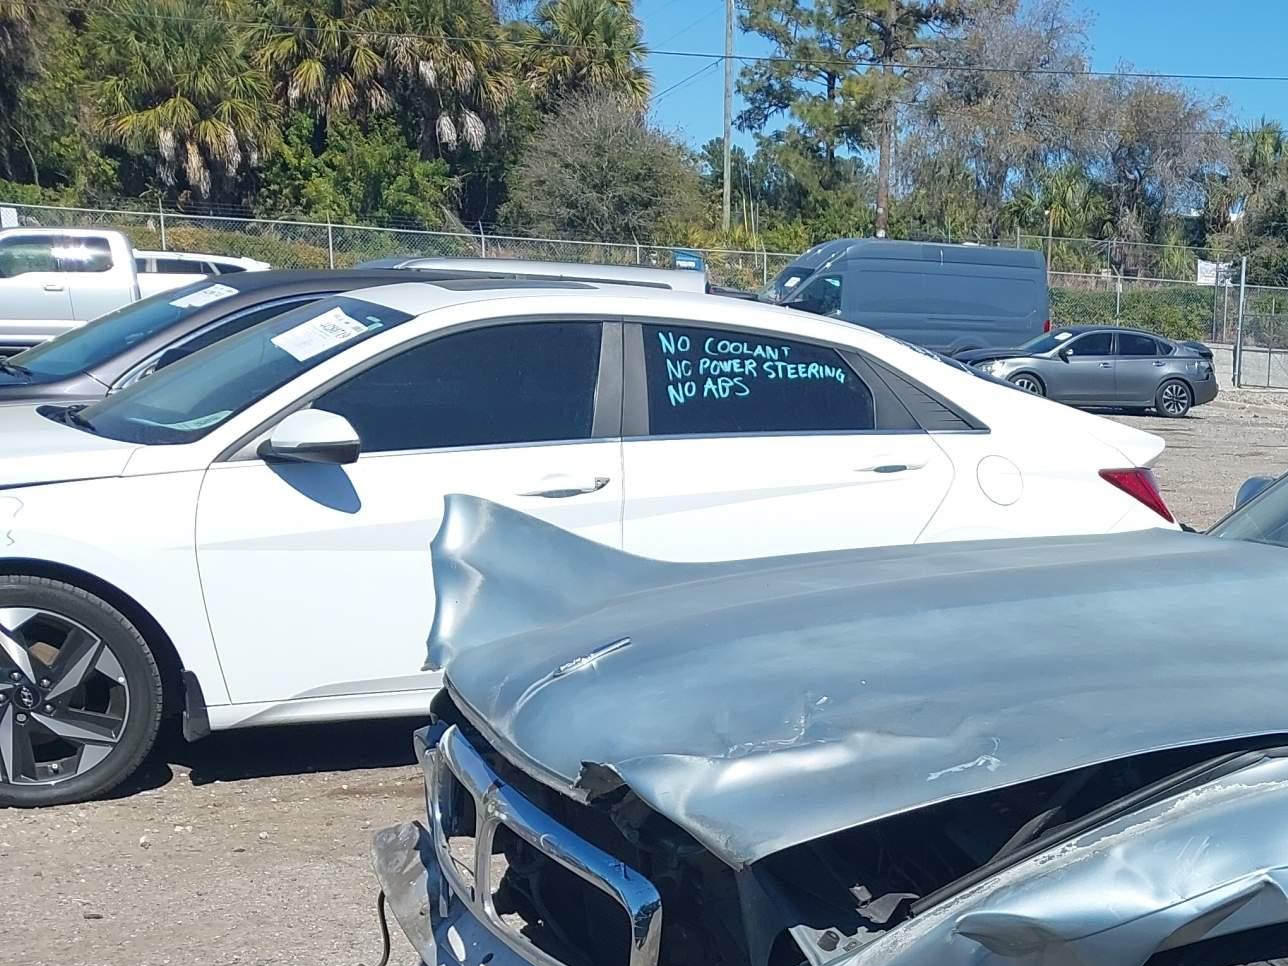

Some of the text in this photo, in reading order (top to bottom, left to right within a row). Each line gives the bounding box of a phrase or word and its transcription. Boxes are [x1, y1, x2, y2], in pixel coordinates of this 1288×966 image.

[658, 331, 791, 360] NO COOLANT
[700, 358, 757, 377] POWER
[762, 361, 846, 384] STEERING
[667, 376, 750, 406] NO ABS
